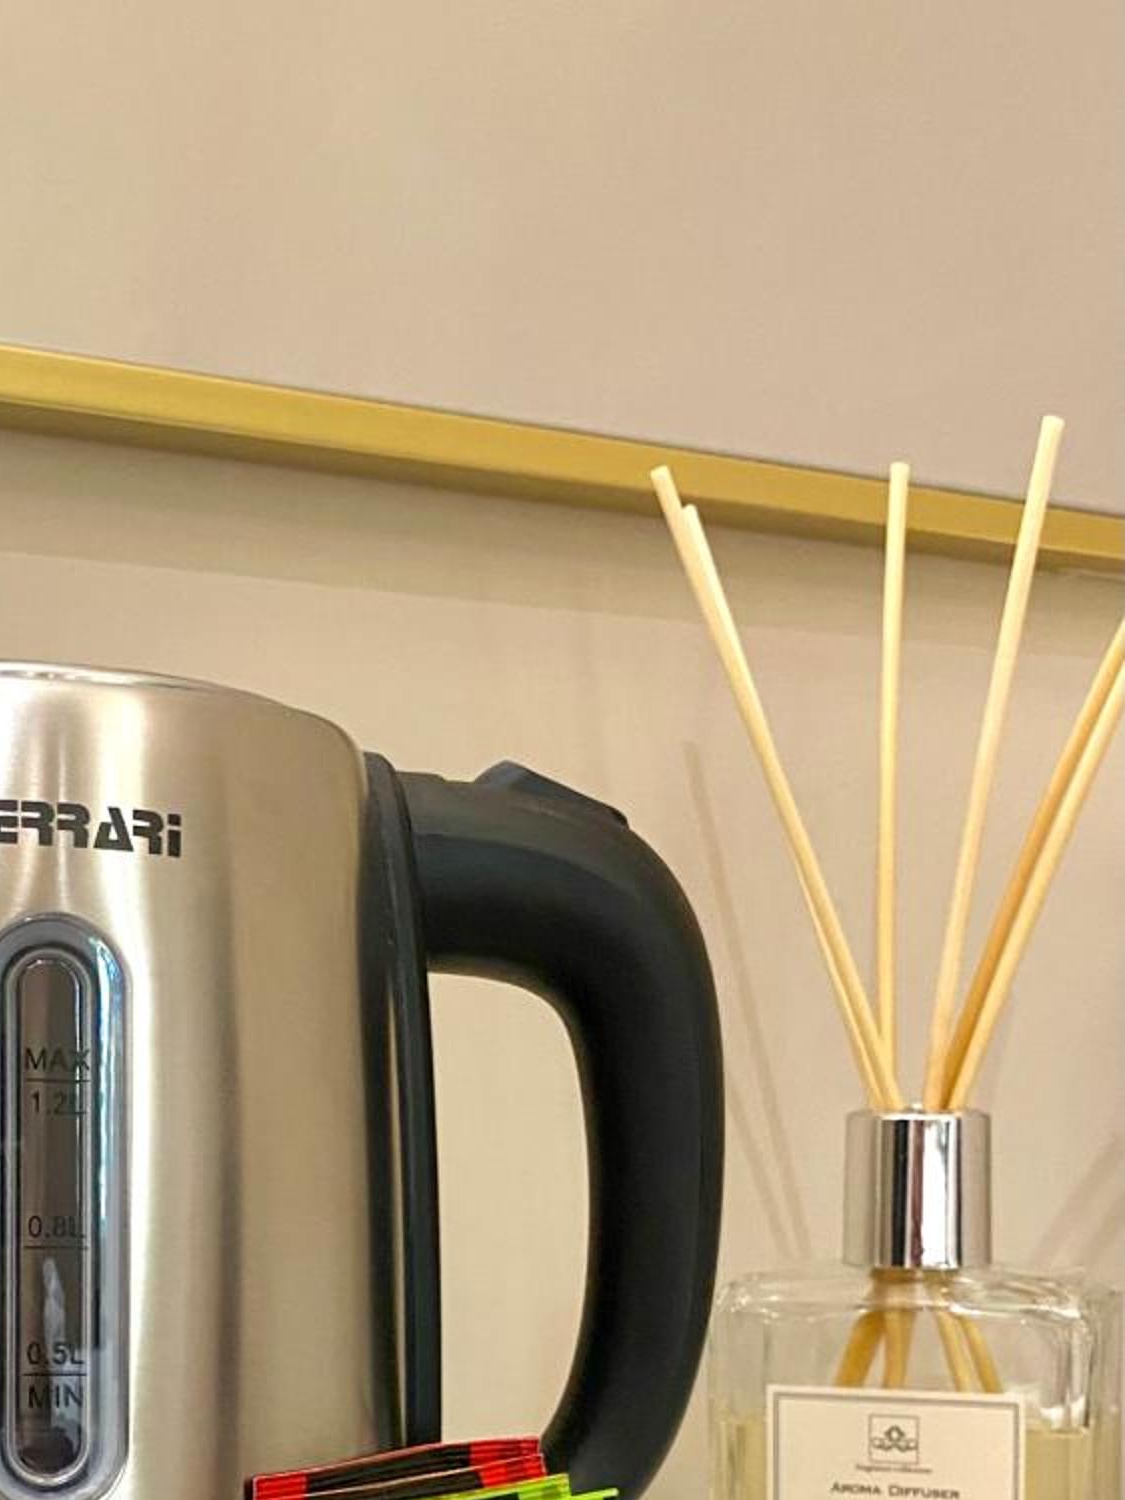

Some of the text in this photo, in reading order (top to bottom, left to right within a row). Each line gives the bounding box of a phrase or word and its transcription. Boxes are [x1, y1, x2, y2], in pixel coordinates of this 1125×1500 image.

[25, 1047, 90, 1071] MAX
[26, 1342, 84, 1366] 0.5L
[28, 1385, 84, 1409] MIN
